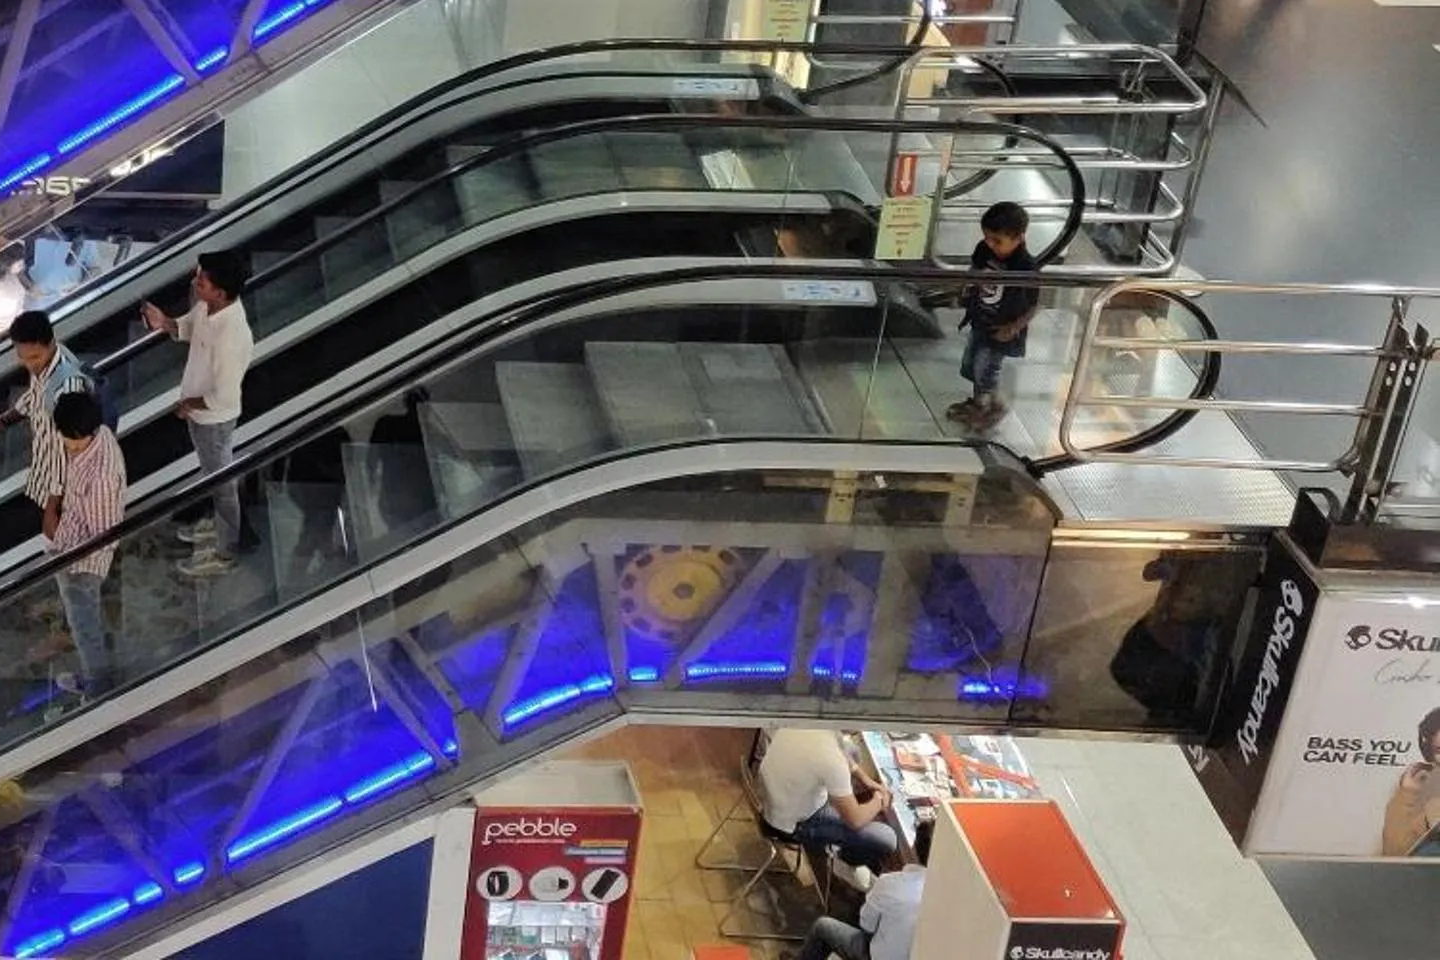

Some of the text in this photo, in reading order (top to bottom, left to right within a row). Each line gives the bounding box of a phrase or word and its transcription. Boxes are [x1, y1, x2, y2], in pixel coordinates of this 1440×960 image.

[1307, 736, 1412, 754] BASS YOU
[1303, 749, 1347, 764] CAN
[482, 817, 577, 845] pebble
[1025, 947, 1111, 960] Skullcandy
